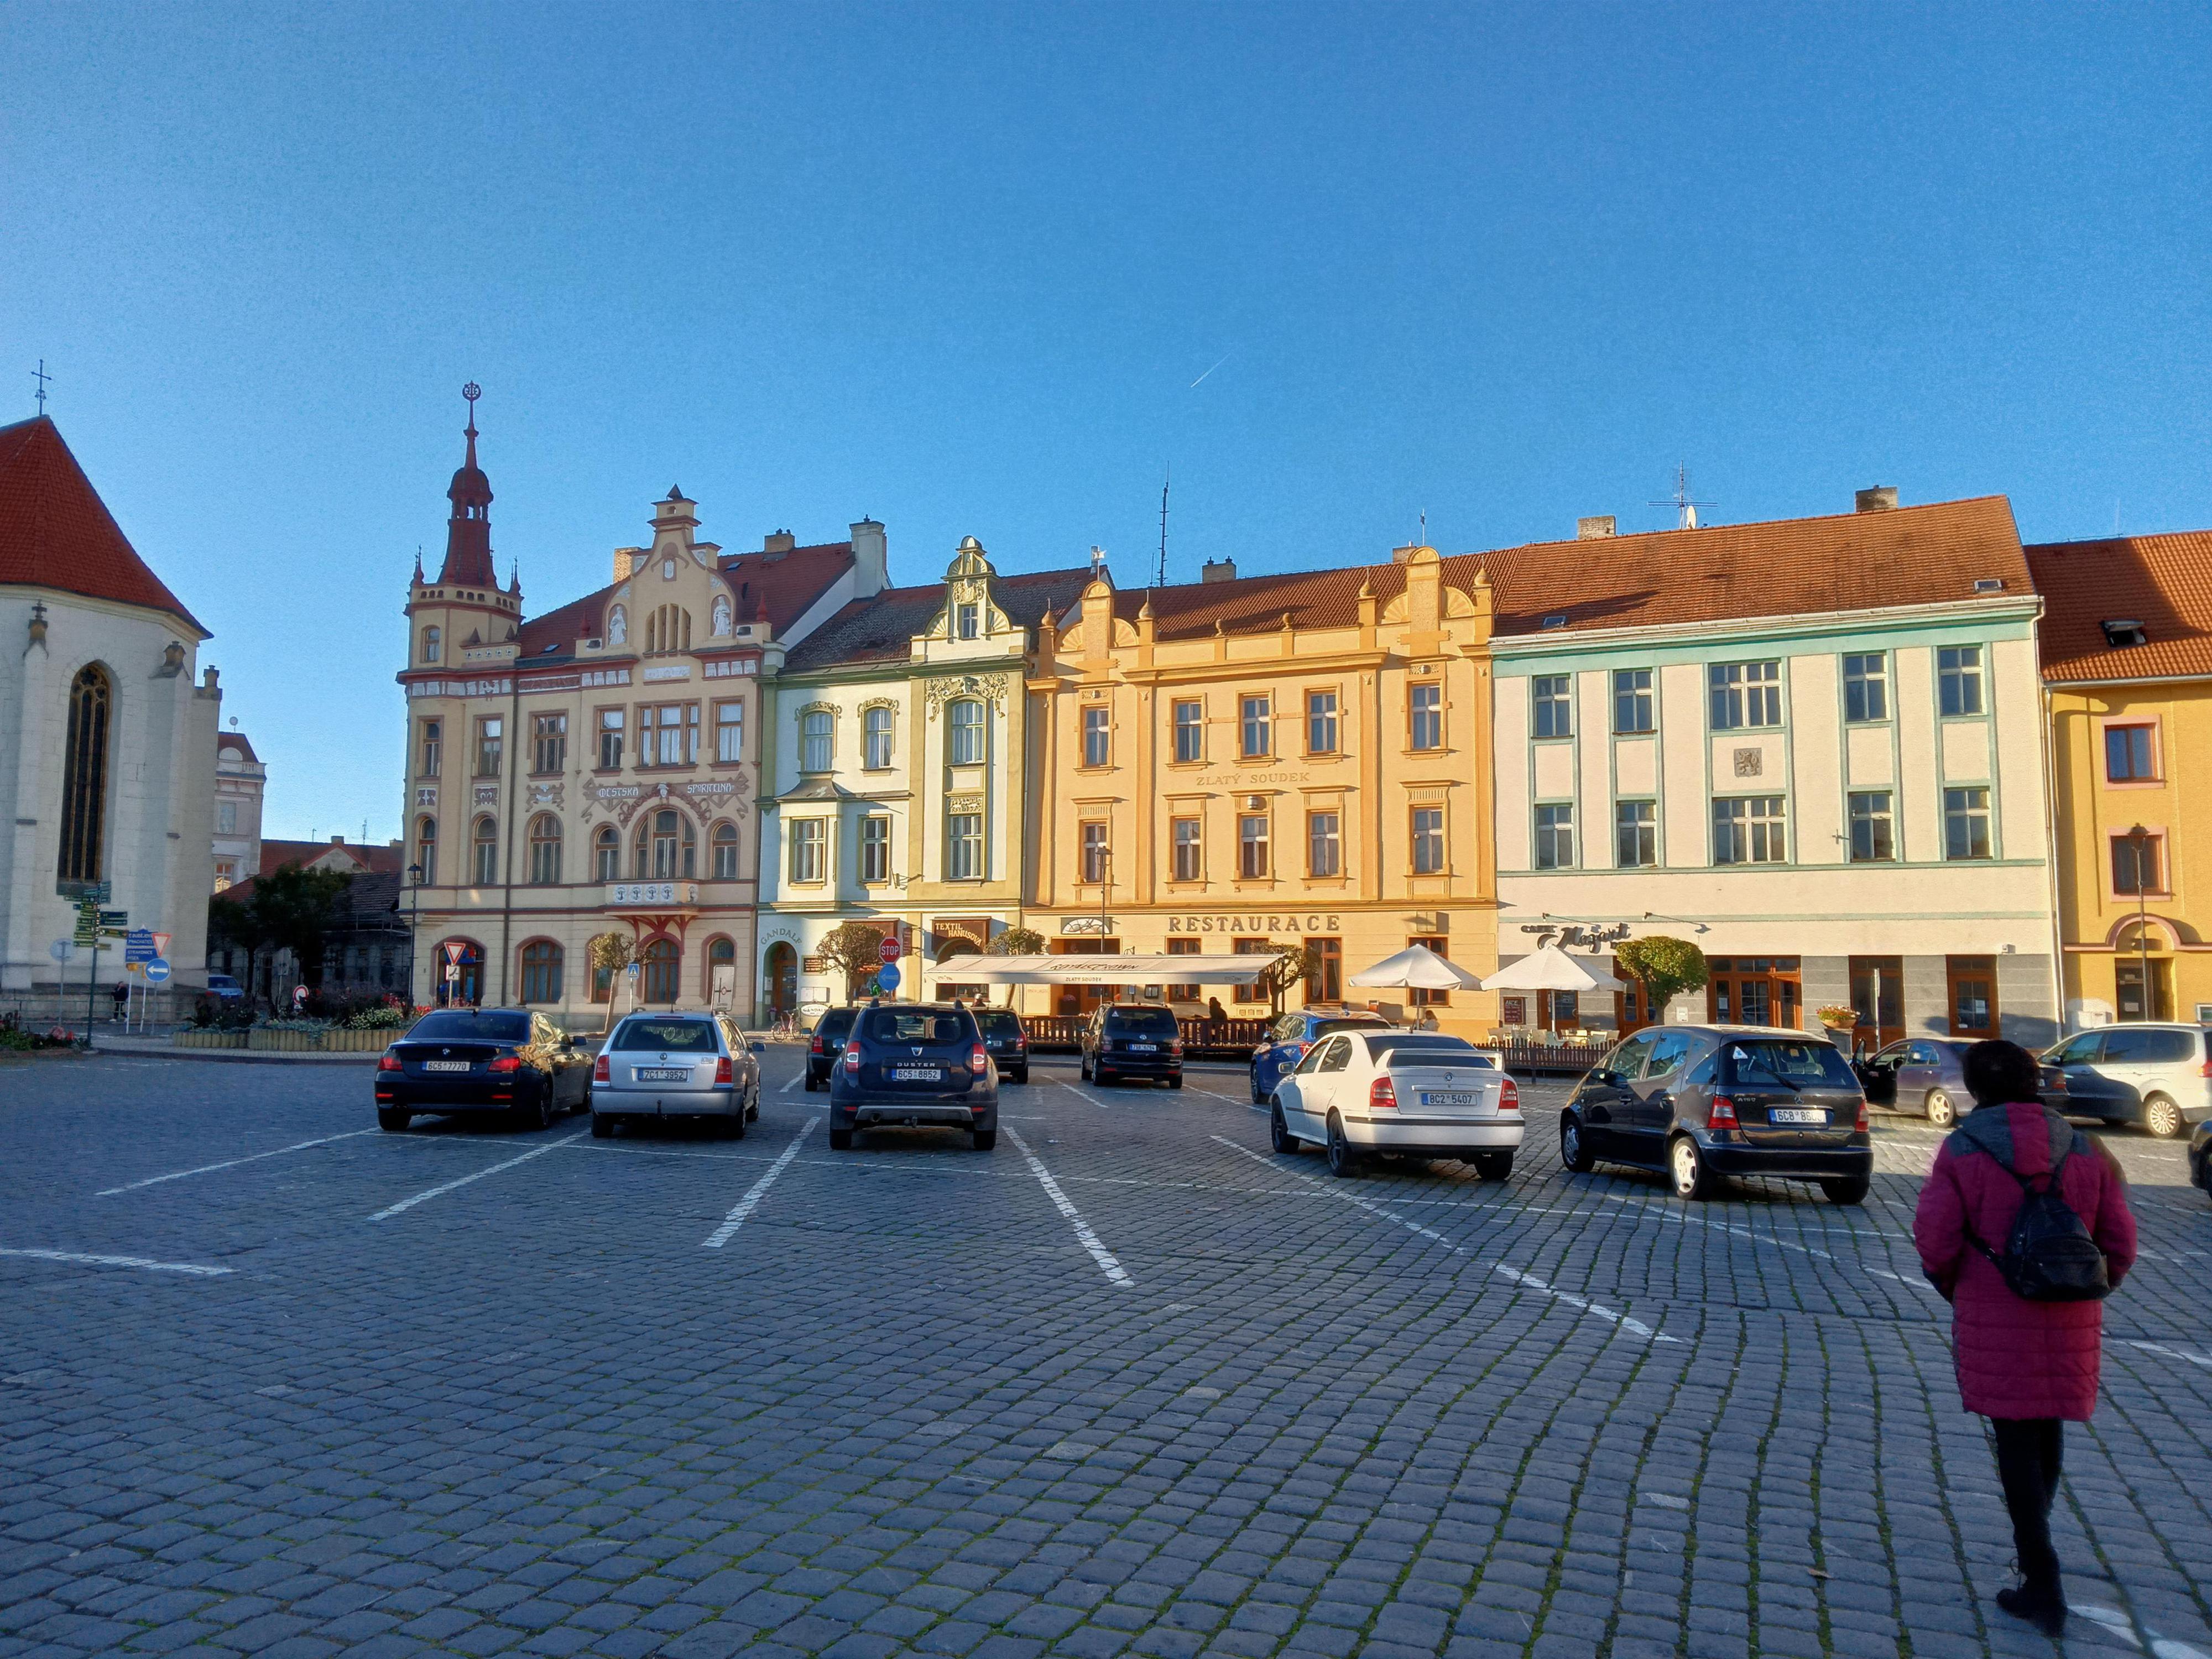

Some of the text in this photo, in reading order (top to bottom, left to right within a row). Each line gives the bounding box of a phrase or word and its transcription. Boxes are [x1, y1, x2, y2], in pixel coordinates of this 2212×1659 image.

[1197, 773, 1310, 785] ZLATÝ SOUDEK
[1168, 915, 1340, 932] RESTAURACE
[760, 928, 802, 945] GANDALF
[881, 946, 899, 956] STOP
[448, 1062, 467, 1071] 7770
[644, 1071, 684, 1079] 7C1 3952
[918, 1070, 937, 1078] 8852
[1430, 1094, 1472, 1104] 8C2 5407
[1777, 1111, 1794, 1121] 6C8
